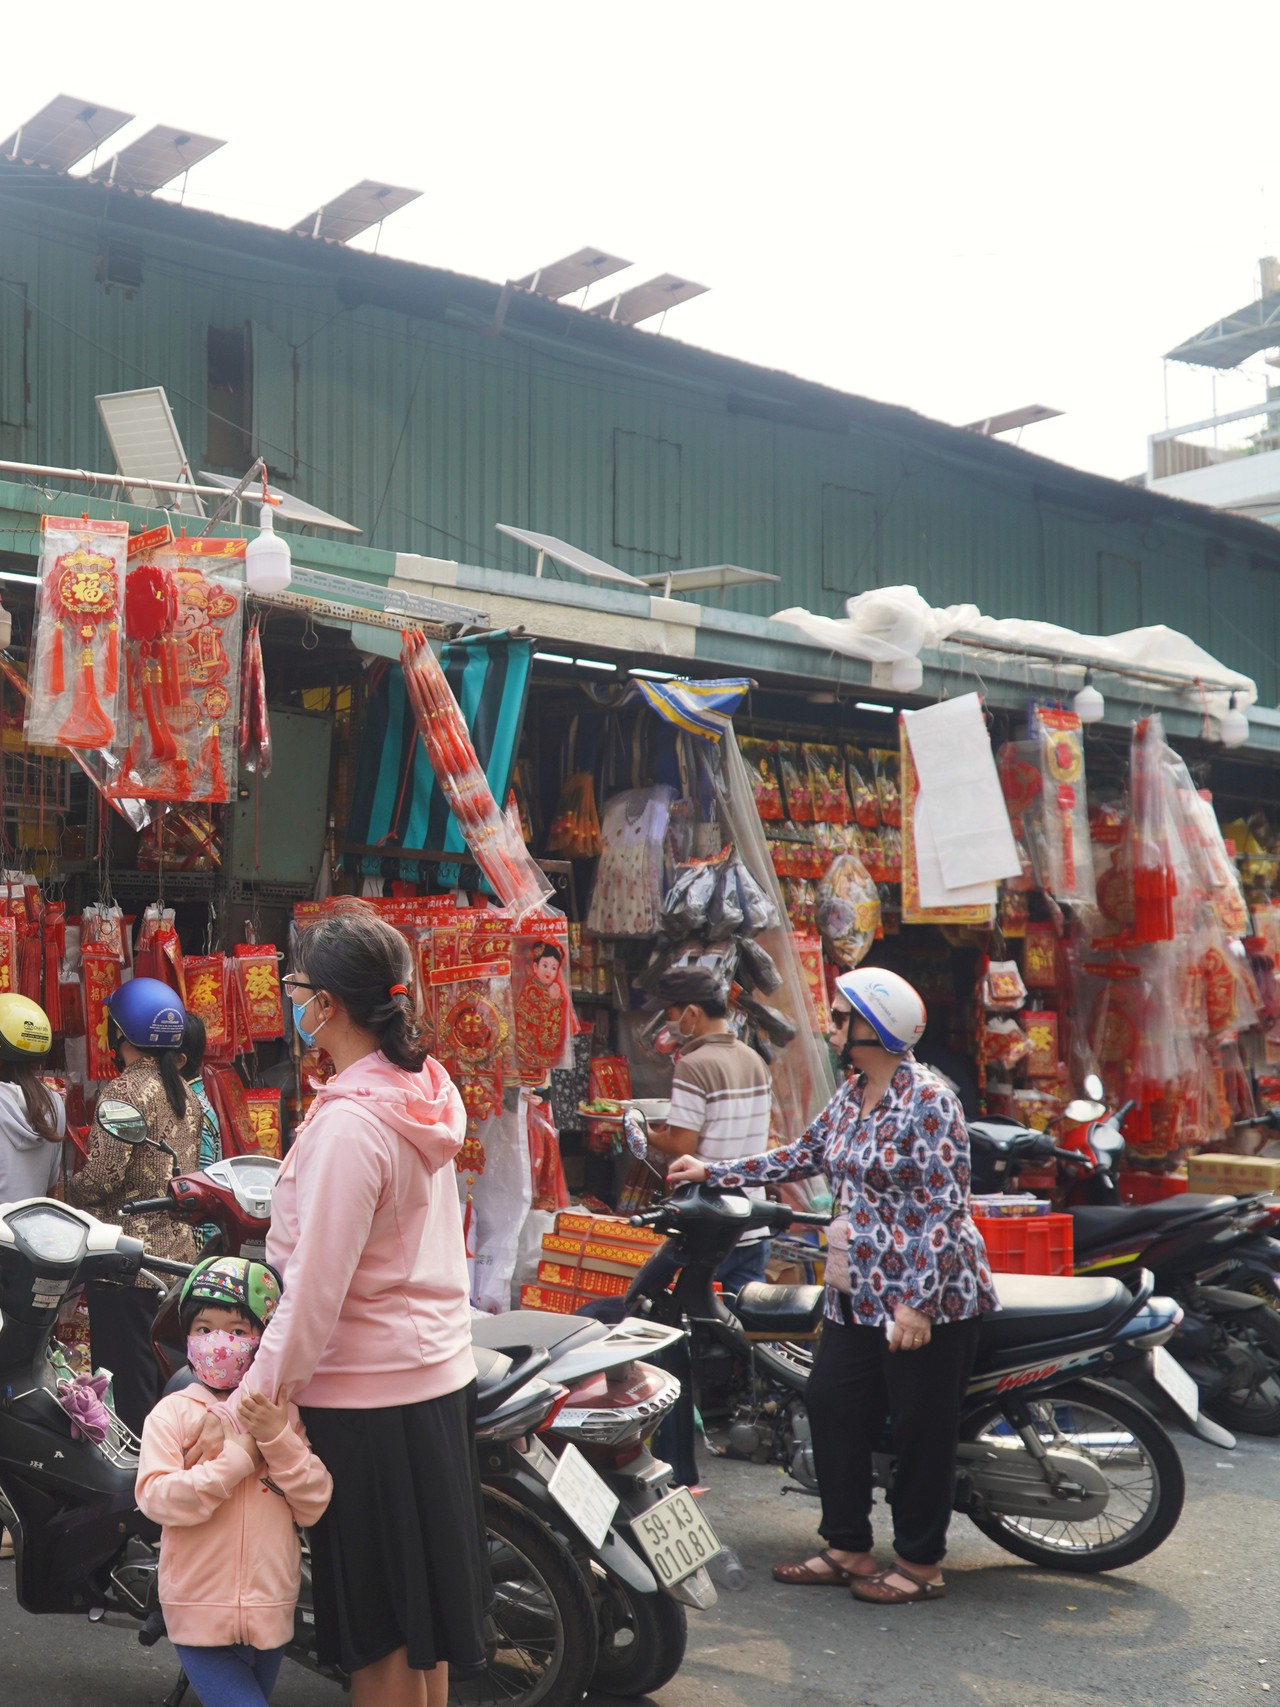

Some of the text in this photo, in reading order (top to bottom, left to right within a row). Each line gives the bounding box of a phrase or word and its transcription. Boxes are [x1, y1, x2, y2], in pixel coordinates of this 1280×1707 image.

[71, 572, 104, 602] 福
[244, 964, 279, 1000] 發
[641, 1498, 693, 1545] 59-X3
[654, 1524, 715, 1580] 010.81
